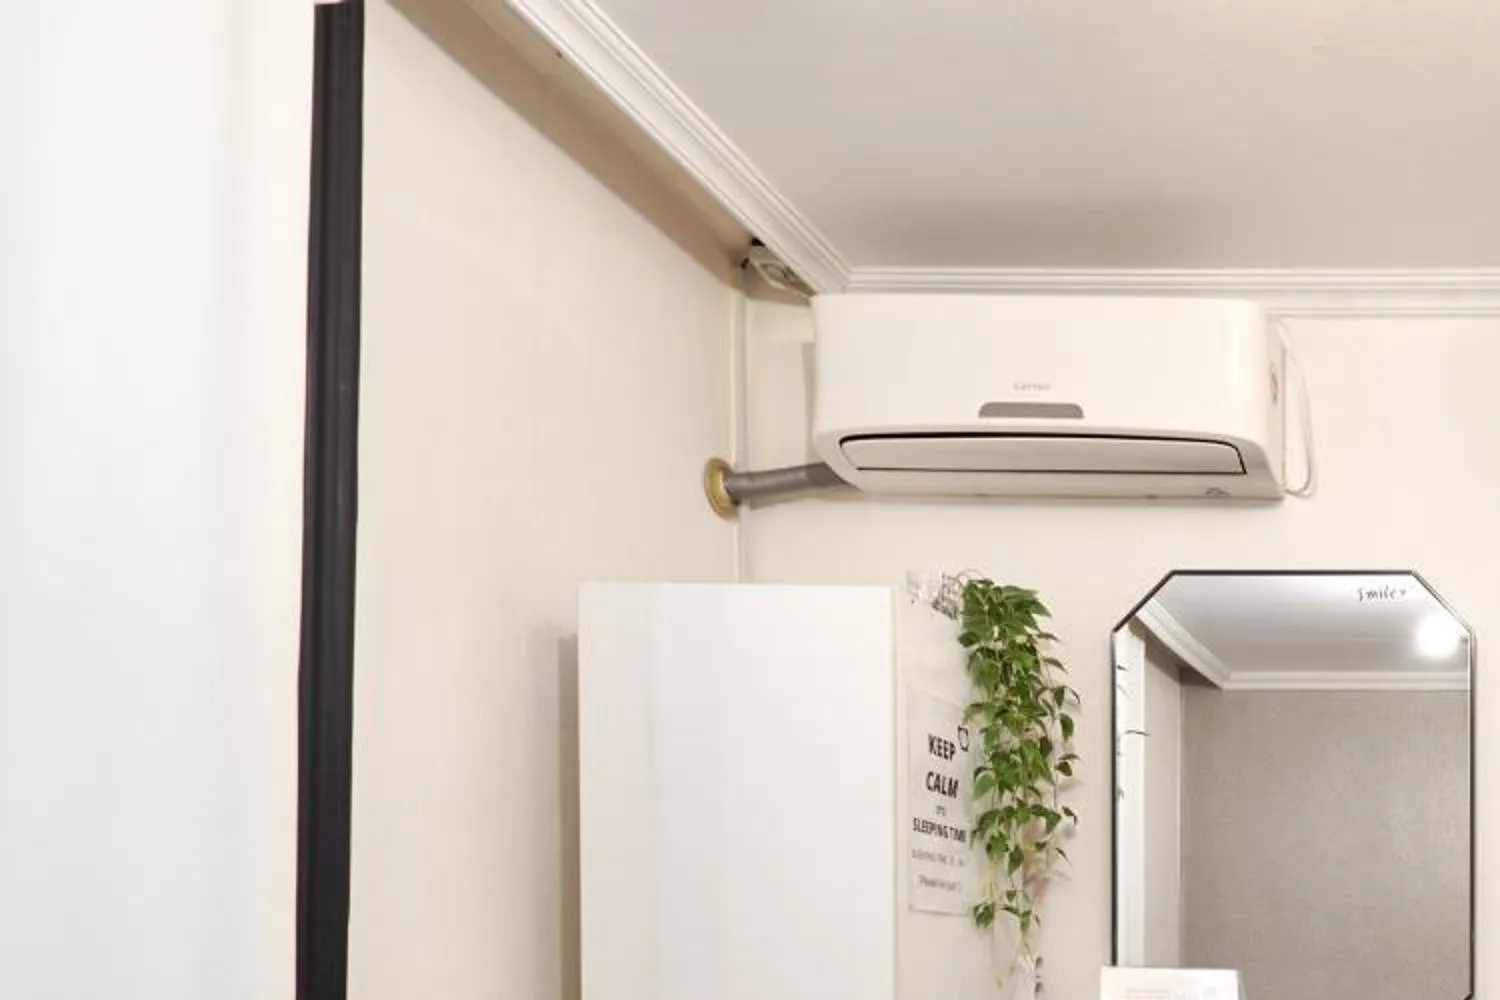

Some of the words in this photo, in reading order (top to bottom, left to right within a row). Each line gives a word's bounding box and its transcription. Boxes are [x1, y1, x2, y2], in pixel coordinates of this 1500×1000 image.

[928, 733, 956, 761] KEEP
[926, 771, 960, 799] CALM
[912, 817, 948, 840] SLEEPING
